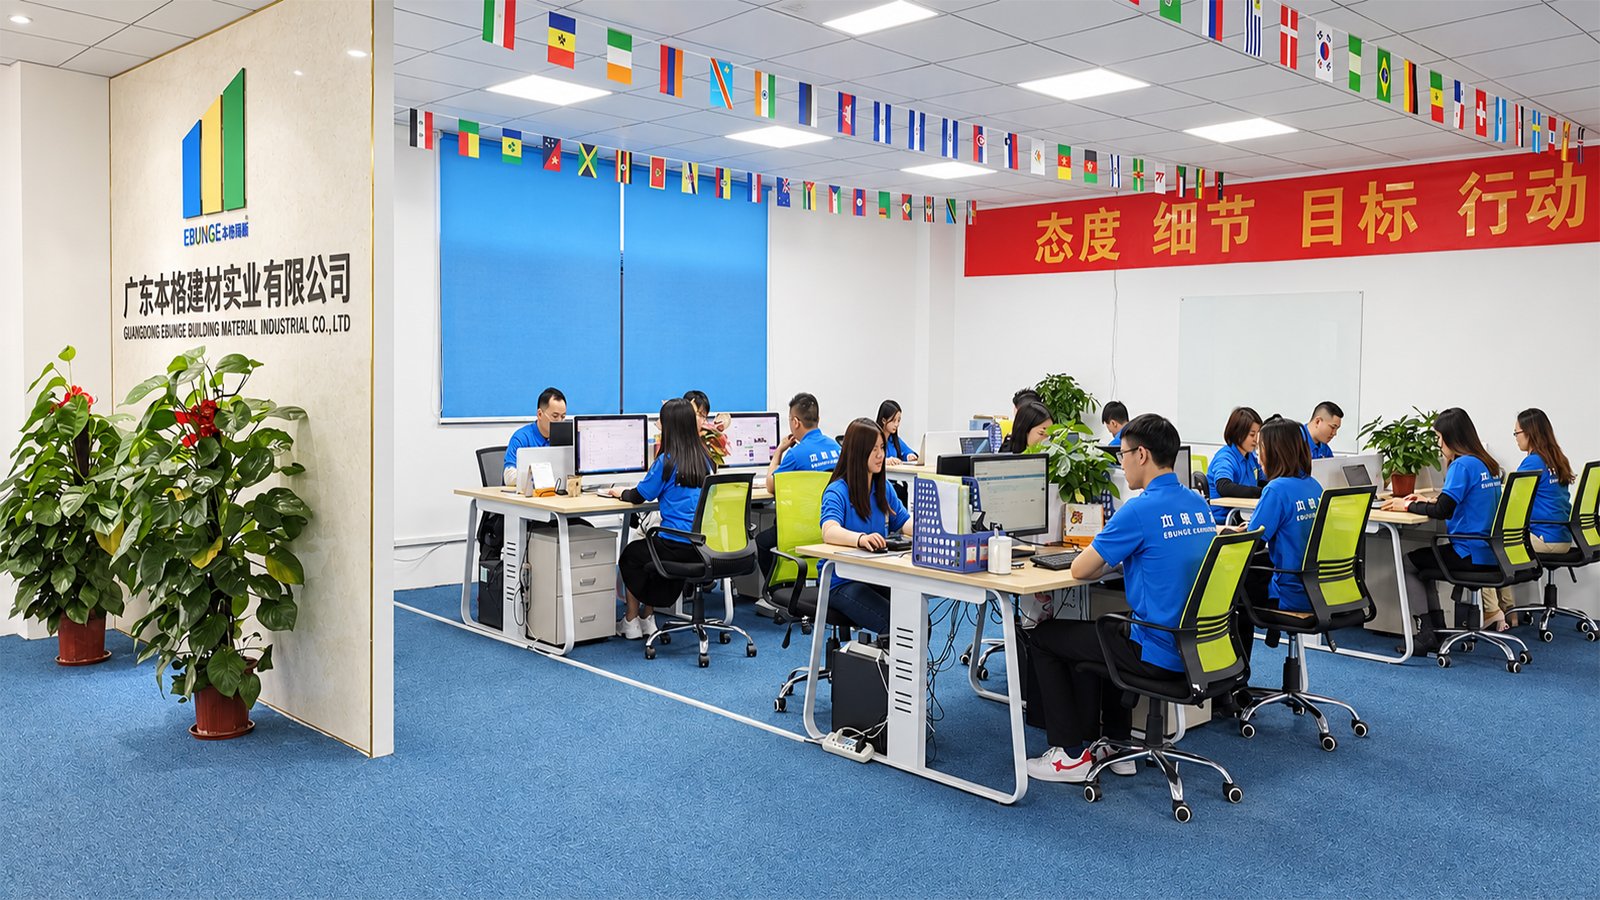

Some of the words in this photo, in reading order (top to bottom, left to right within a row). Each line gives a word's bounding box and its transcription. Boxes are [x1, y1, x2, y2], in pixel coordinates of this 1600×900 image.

[183, 222, 222, 247] EBUNGE
[1034, 207, 1121, 264] 态度
[1152, 194, 1255, 256] 细节
[1301, 181, 1418, 248] 目标
[1457, 162, 1587, 237] 行动
[123, 252, 350, 319] 广东本格建材实业有限公司
[123, 324, 161, 340] GUANGDONG
[161, 322, 187, 339] EBUNGE
[187, 321, 220, 338] BUILDING
[221, 319, 258, 337] MATERIAL
[260, 316, 310, 335] INDUSTRIAL
[312, 314, 351, 336] CO.,LTD
